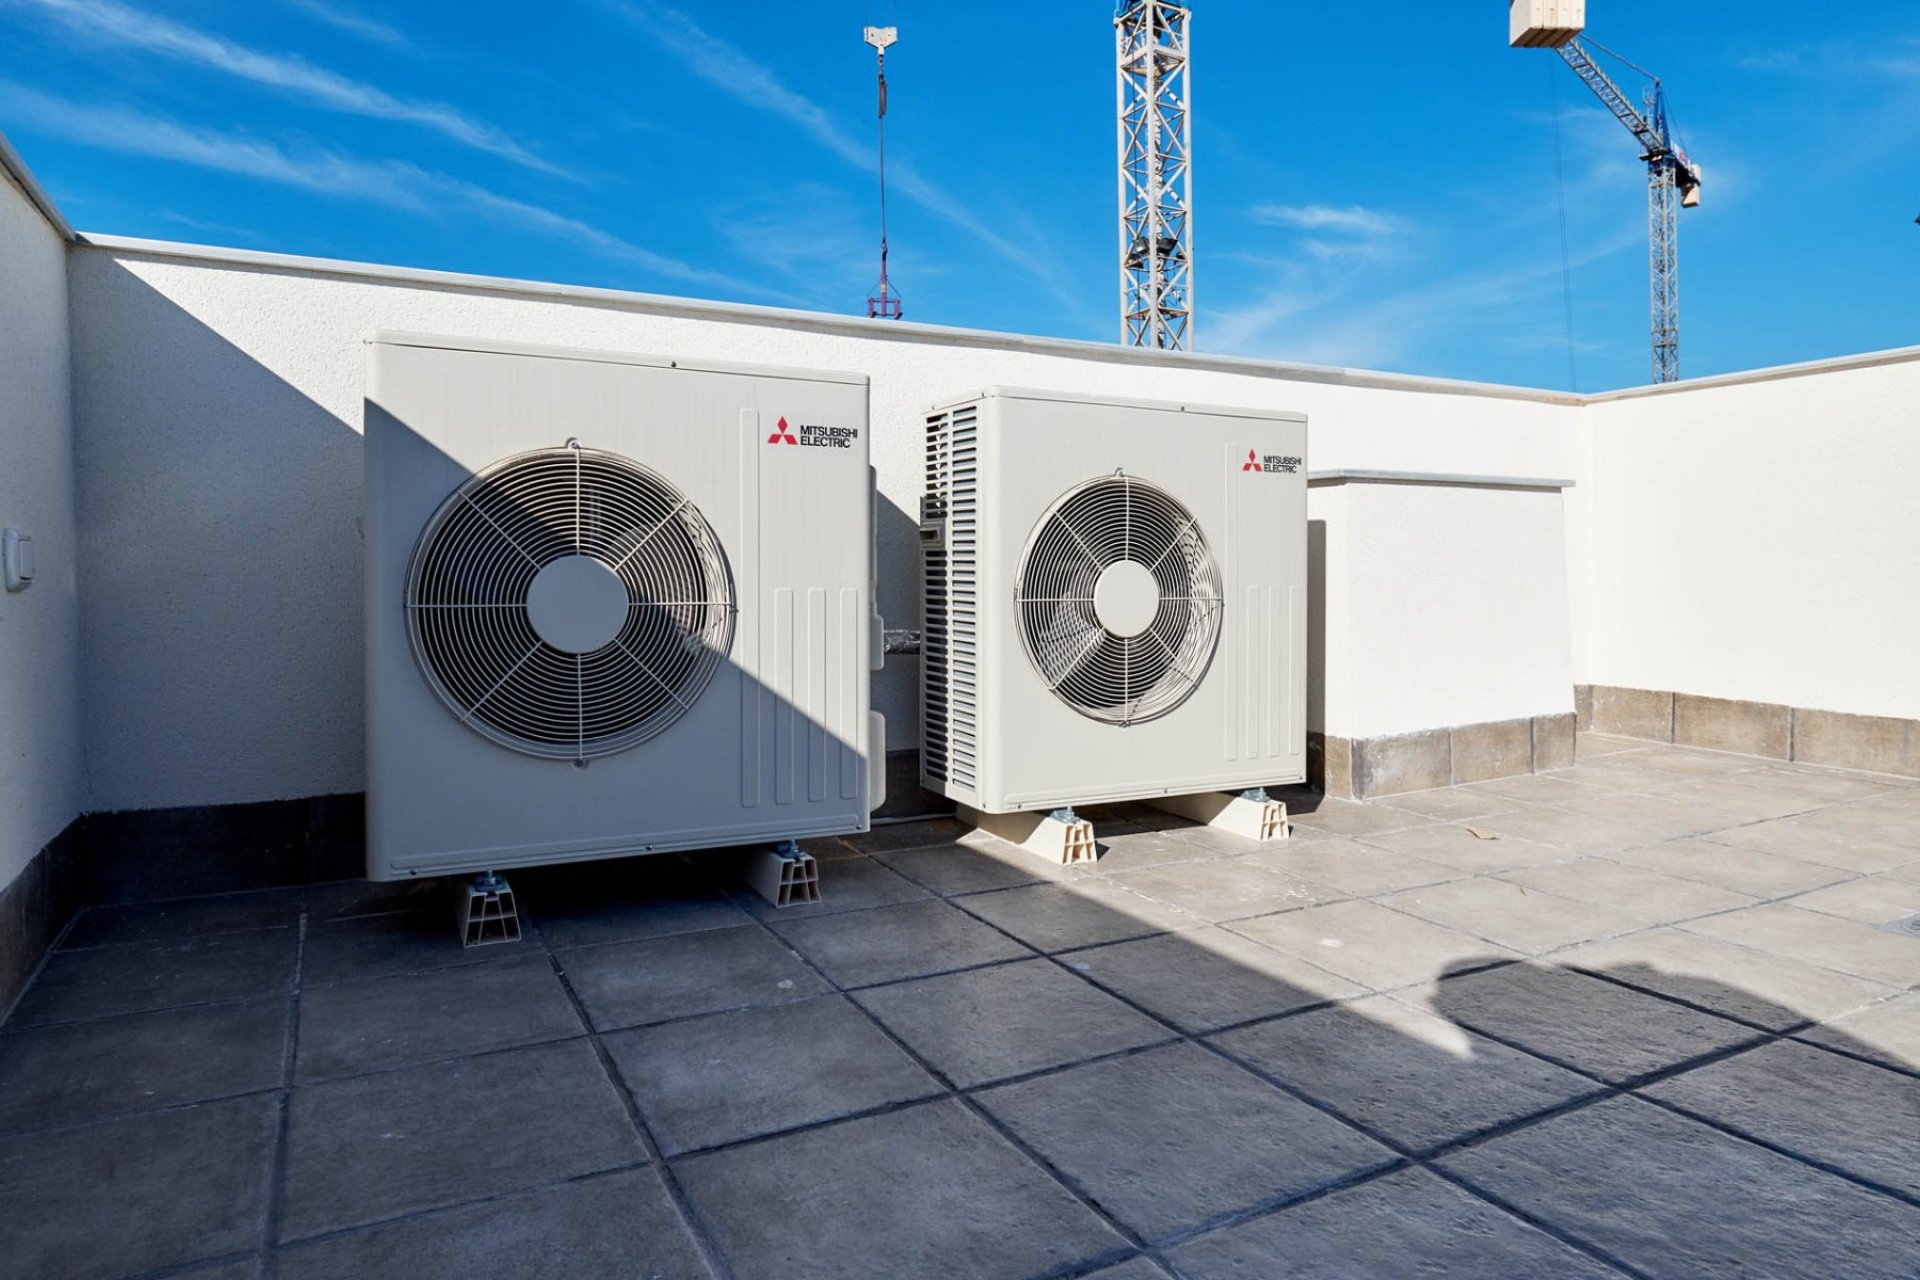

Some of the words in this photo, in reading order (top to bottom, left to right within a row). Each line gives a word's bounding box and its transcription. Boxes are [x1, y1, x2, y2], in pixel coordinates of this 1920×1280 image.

[800, 425, 858, 438] MITSUBISHI
[800, 436, 851, 448] ELECTRIC
[1264, 456, 1302, 465] MITSUBISHI
[1264, 464, 1297, 473] ELECTRIC
